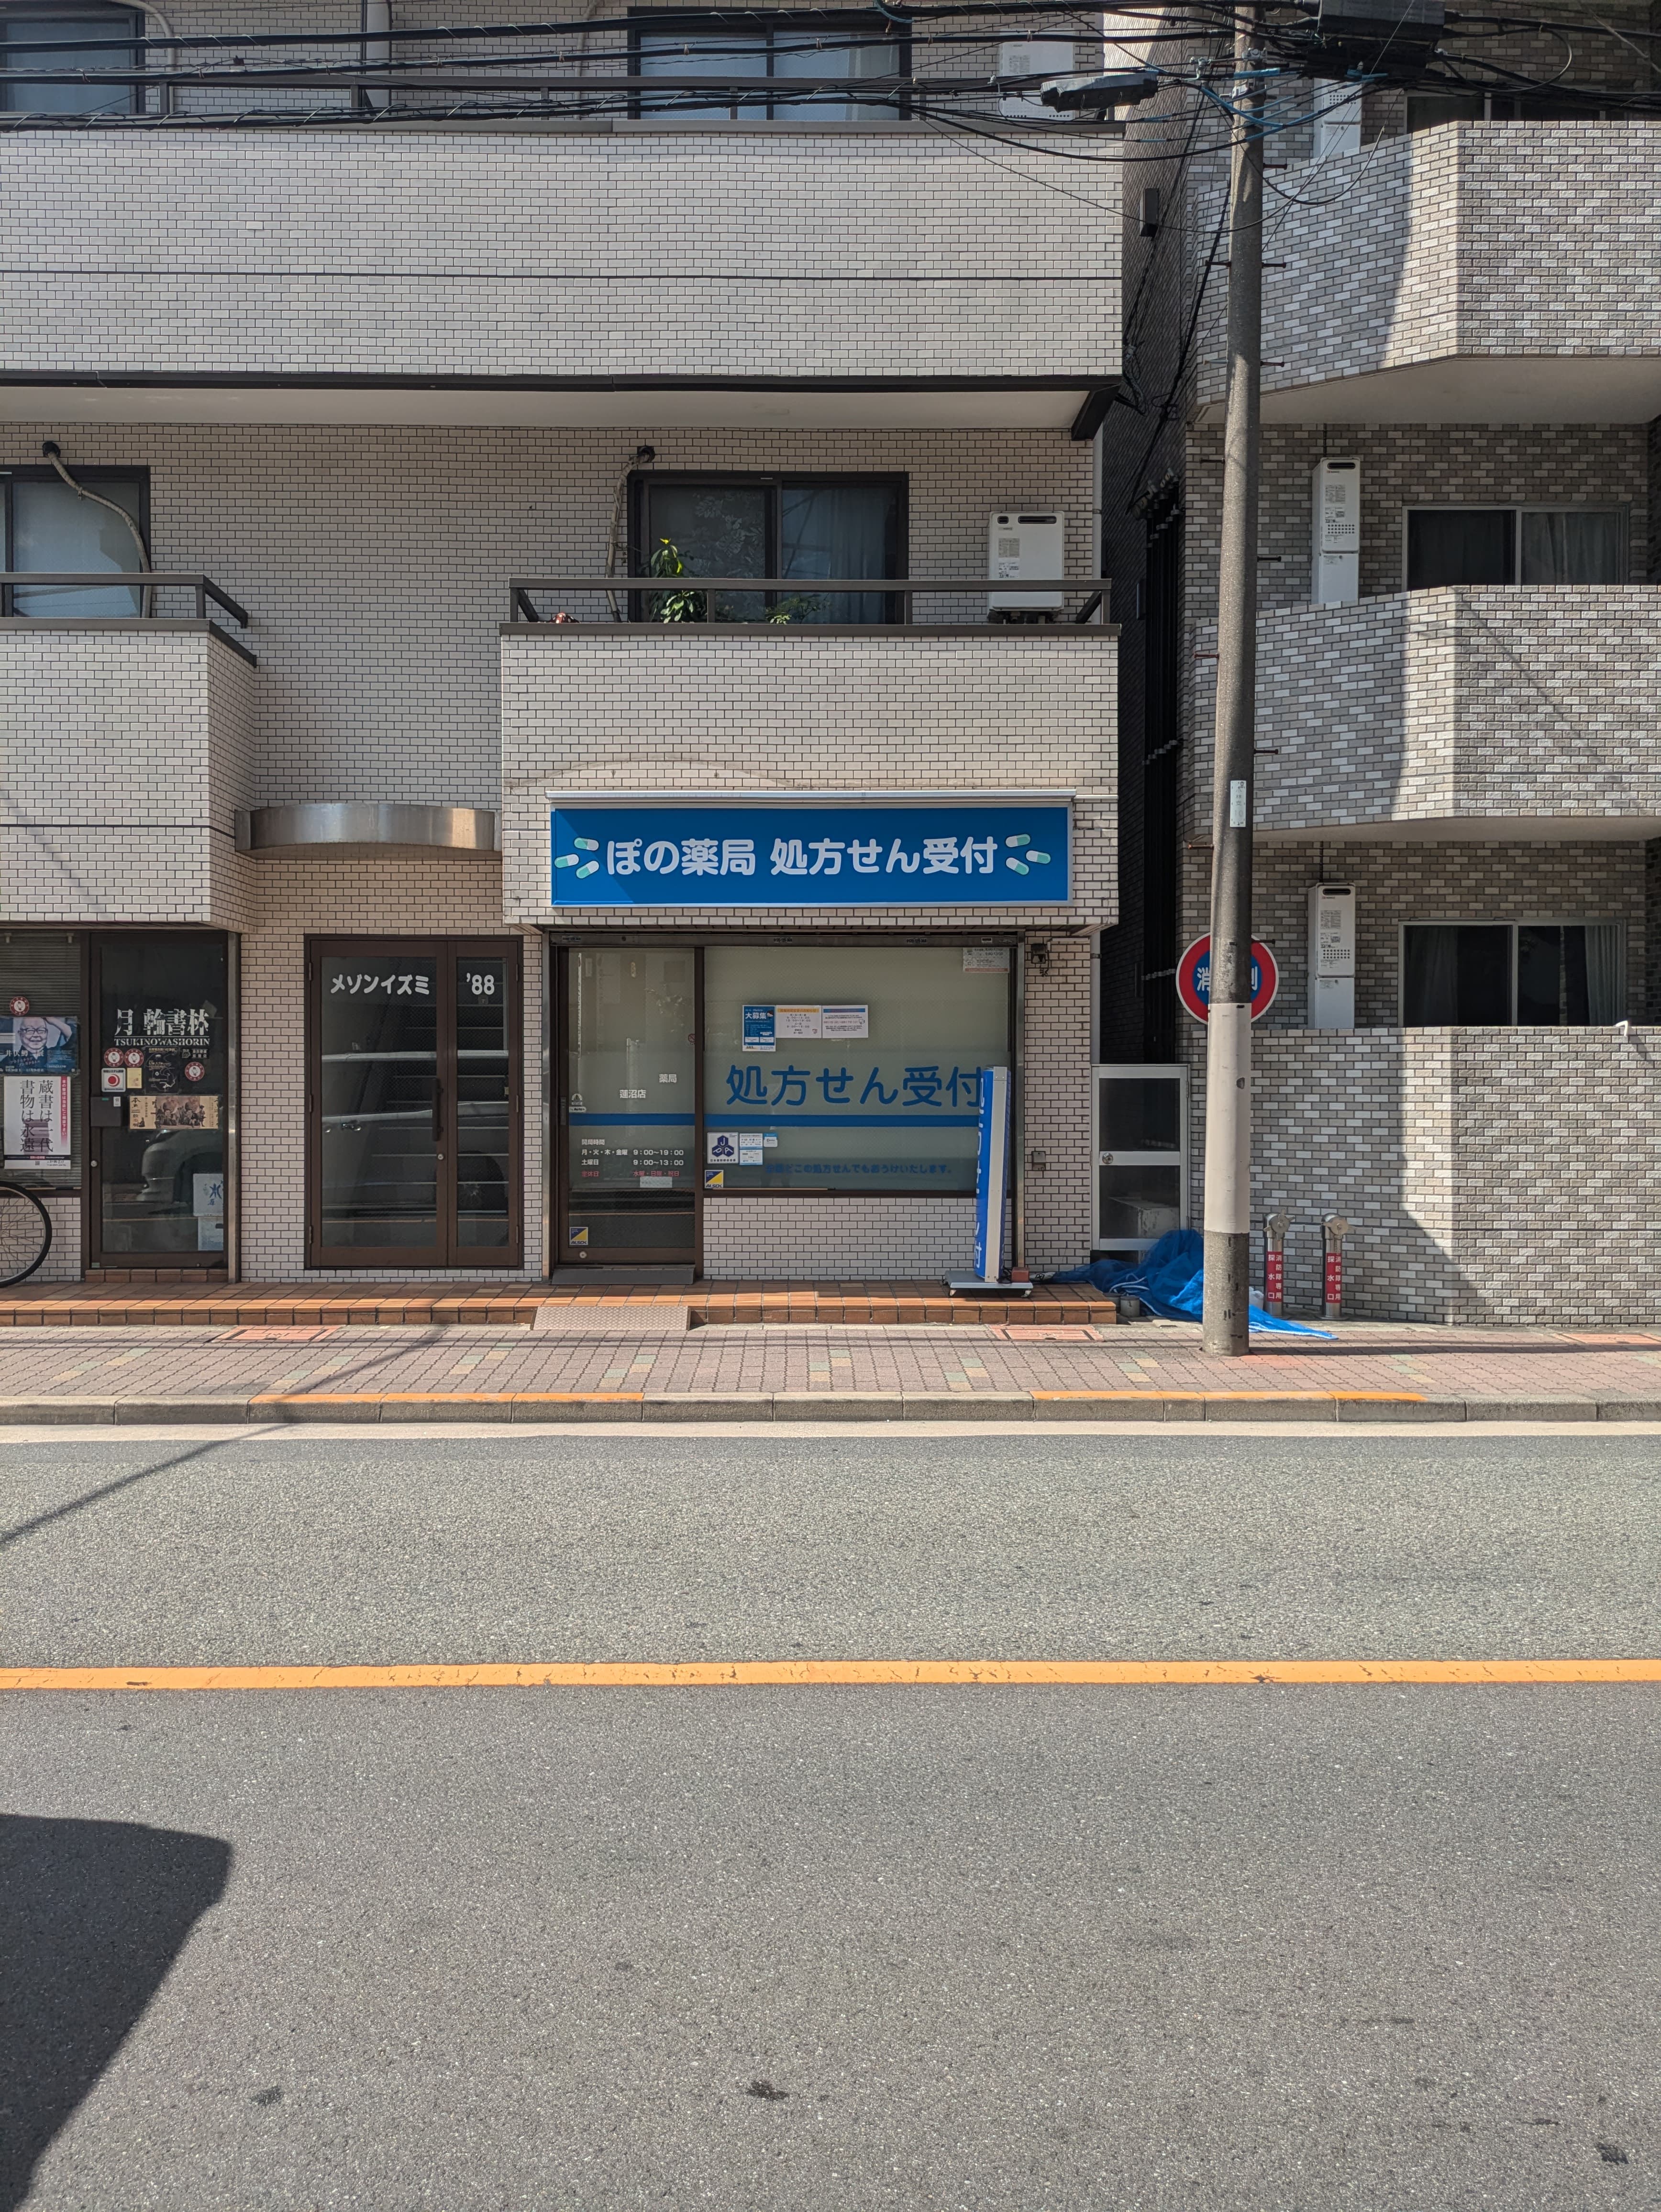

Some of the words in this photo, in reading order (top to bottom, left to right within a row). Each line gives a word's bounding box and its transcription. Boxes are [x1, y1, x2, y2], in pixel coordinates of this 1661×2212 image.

[607, 838, 756, 875] ぽの薬局
[770, 836, 998, 875] 処方せん受付
[331, 974, 430, 995] メゾンイズミ
[466, 973, 495, 995] '88
[114, 1038, 210, 1046] TSUKINOWASHORIN
[659, 1074, 677, 1083] 薬局
[726, 1065, 982, 1106] 処方せん受付
[620, 1089, 646, 1099] 蓮沼店
[20, 1080, 35, 1152] 書物は永遠
[39, 1080, 54, 1152] 蔵書は一代
